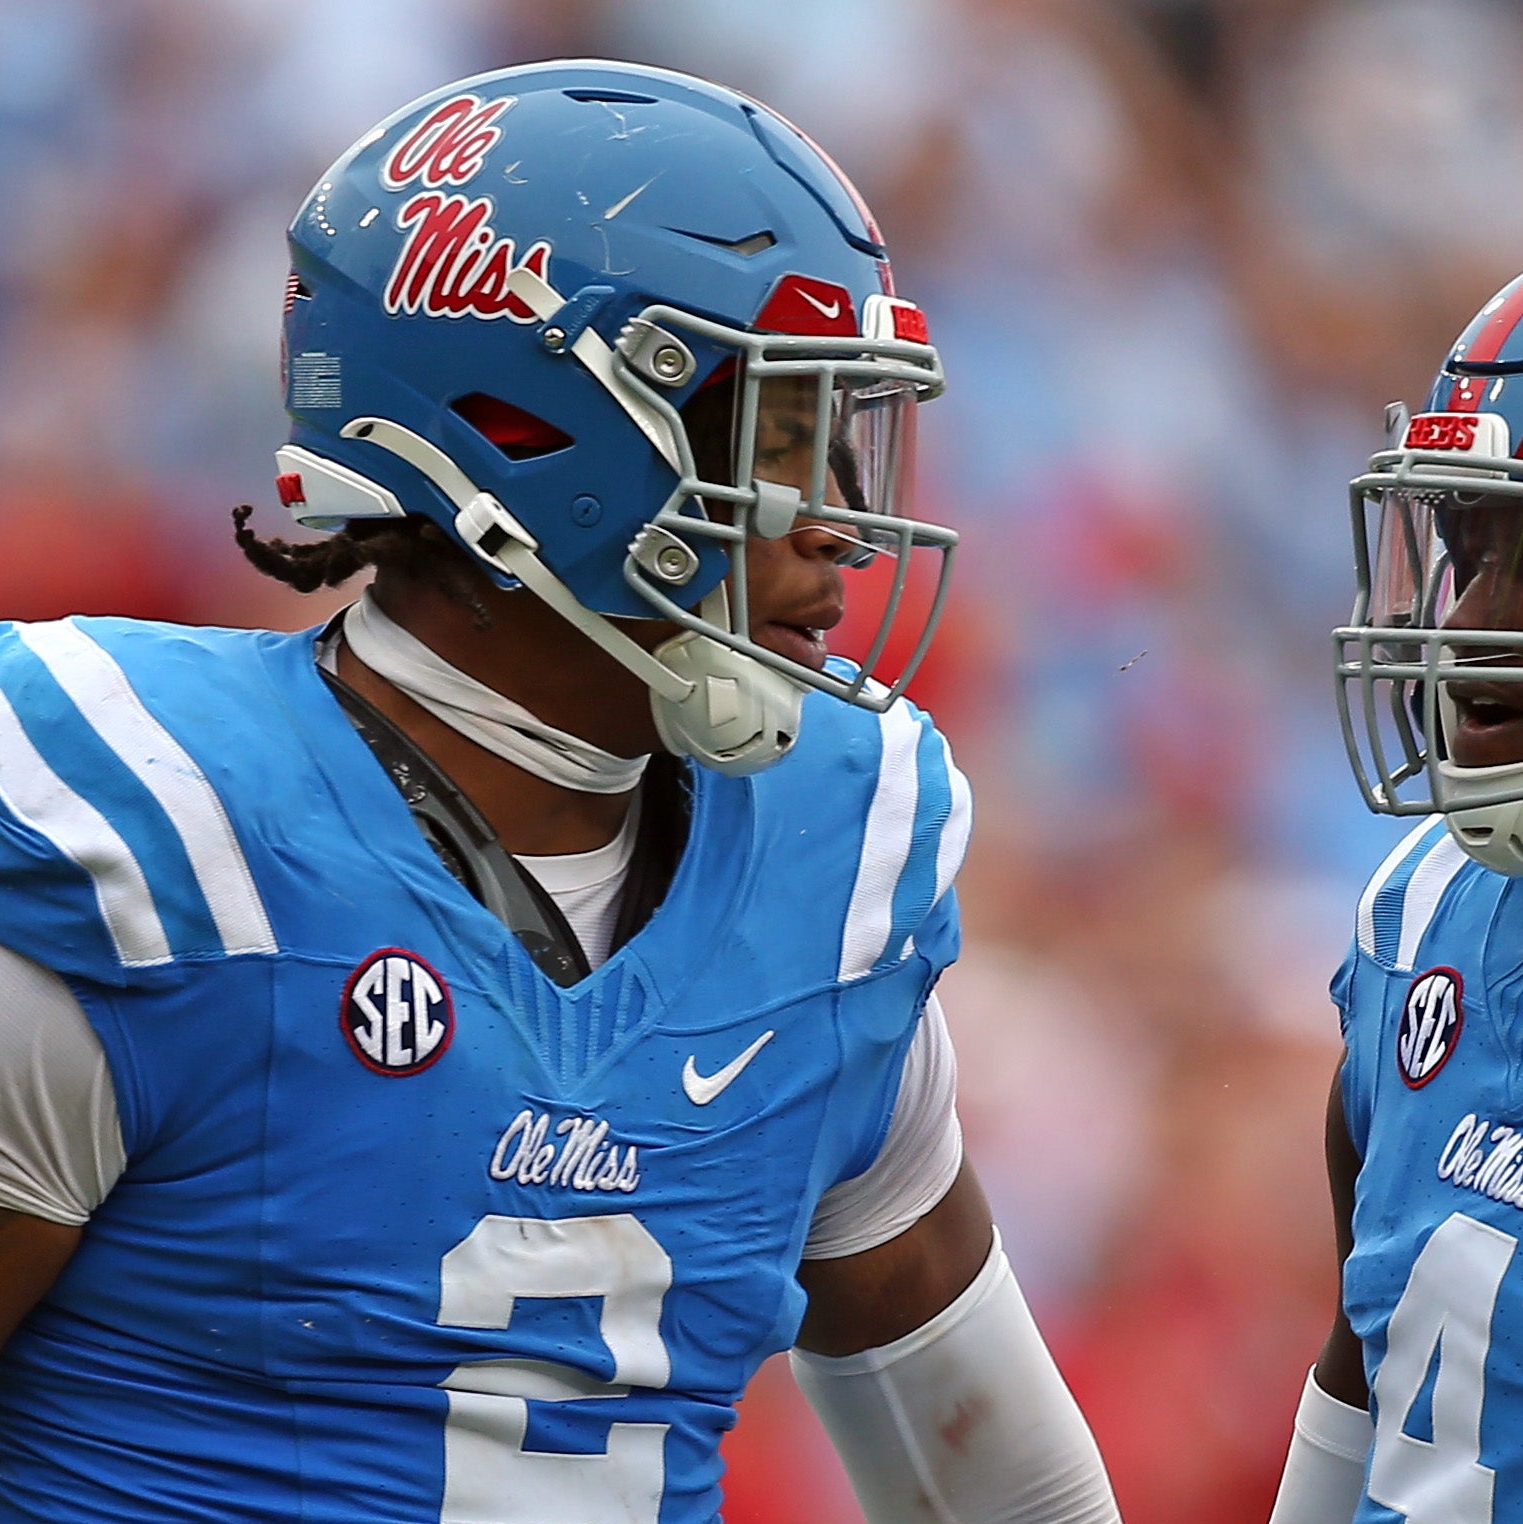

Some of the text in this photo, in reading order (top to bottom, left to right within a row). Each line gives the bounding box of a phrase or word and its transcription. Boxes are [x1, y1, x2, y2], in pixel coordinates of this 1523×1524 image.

[382, 94, 518, 189] Ole
[383, 190, 556, 325] Miss
[351, 957, 444, 1066] SEC
[1400, 973, 1458, 1079] SEC
[488, 1108, 642, 1194] Ole Miss
[1437, 1112, 1490, 1188] Ole
